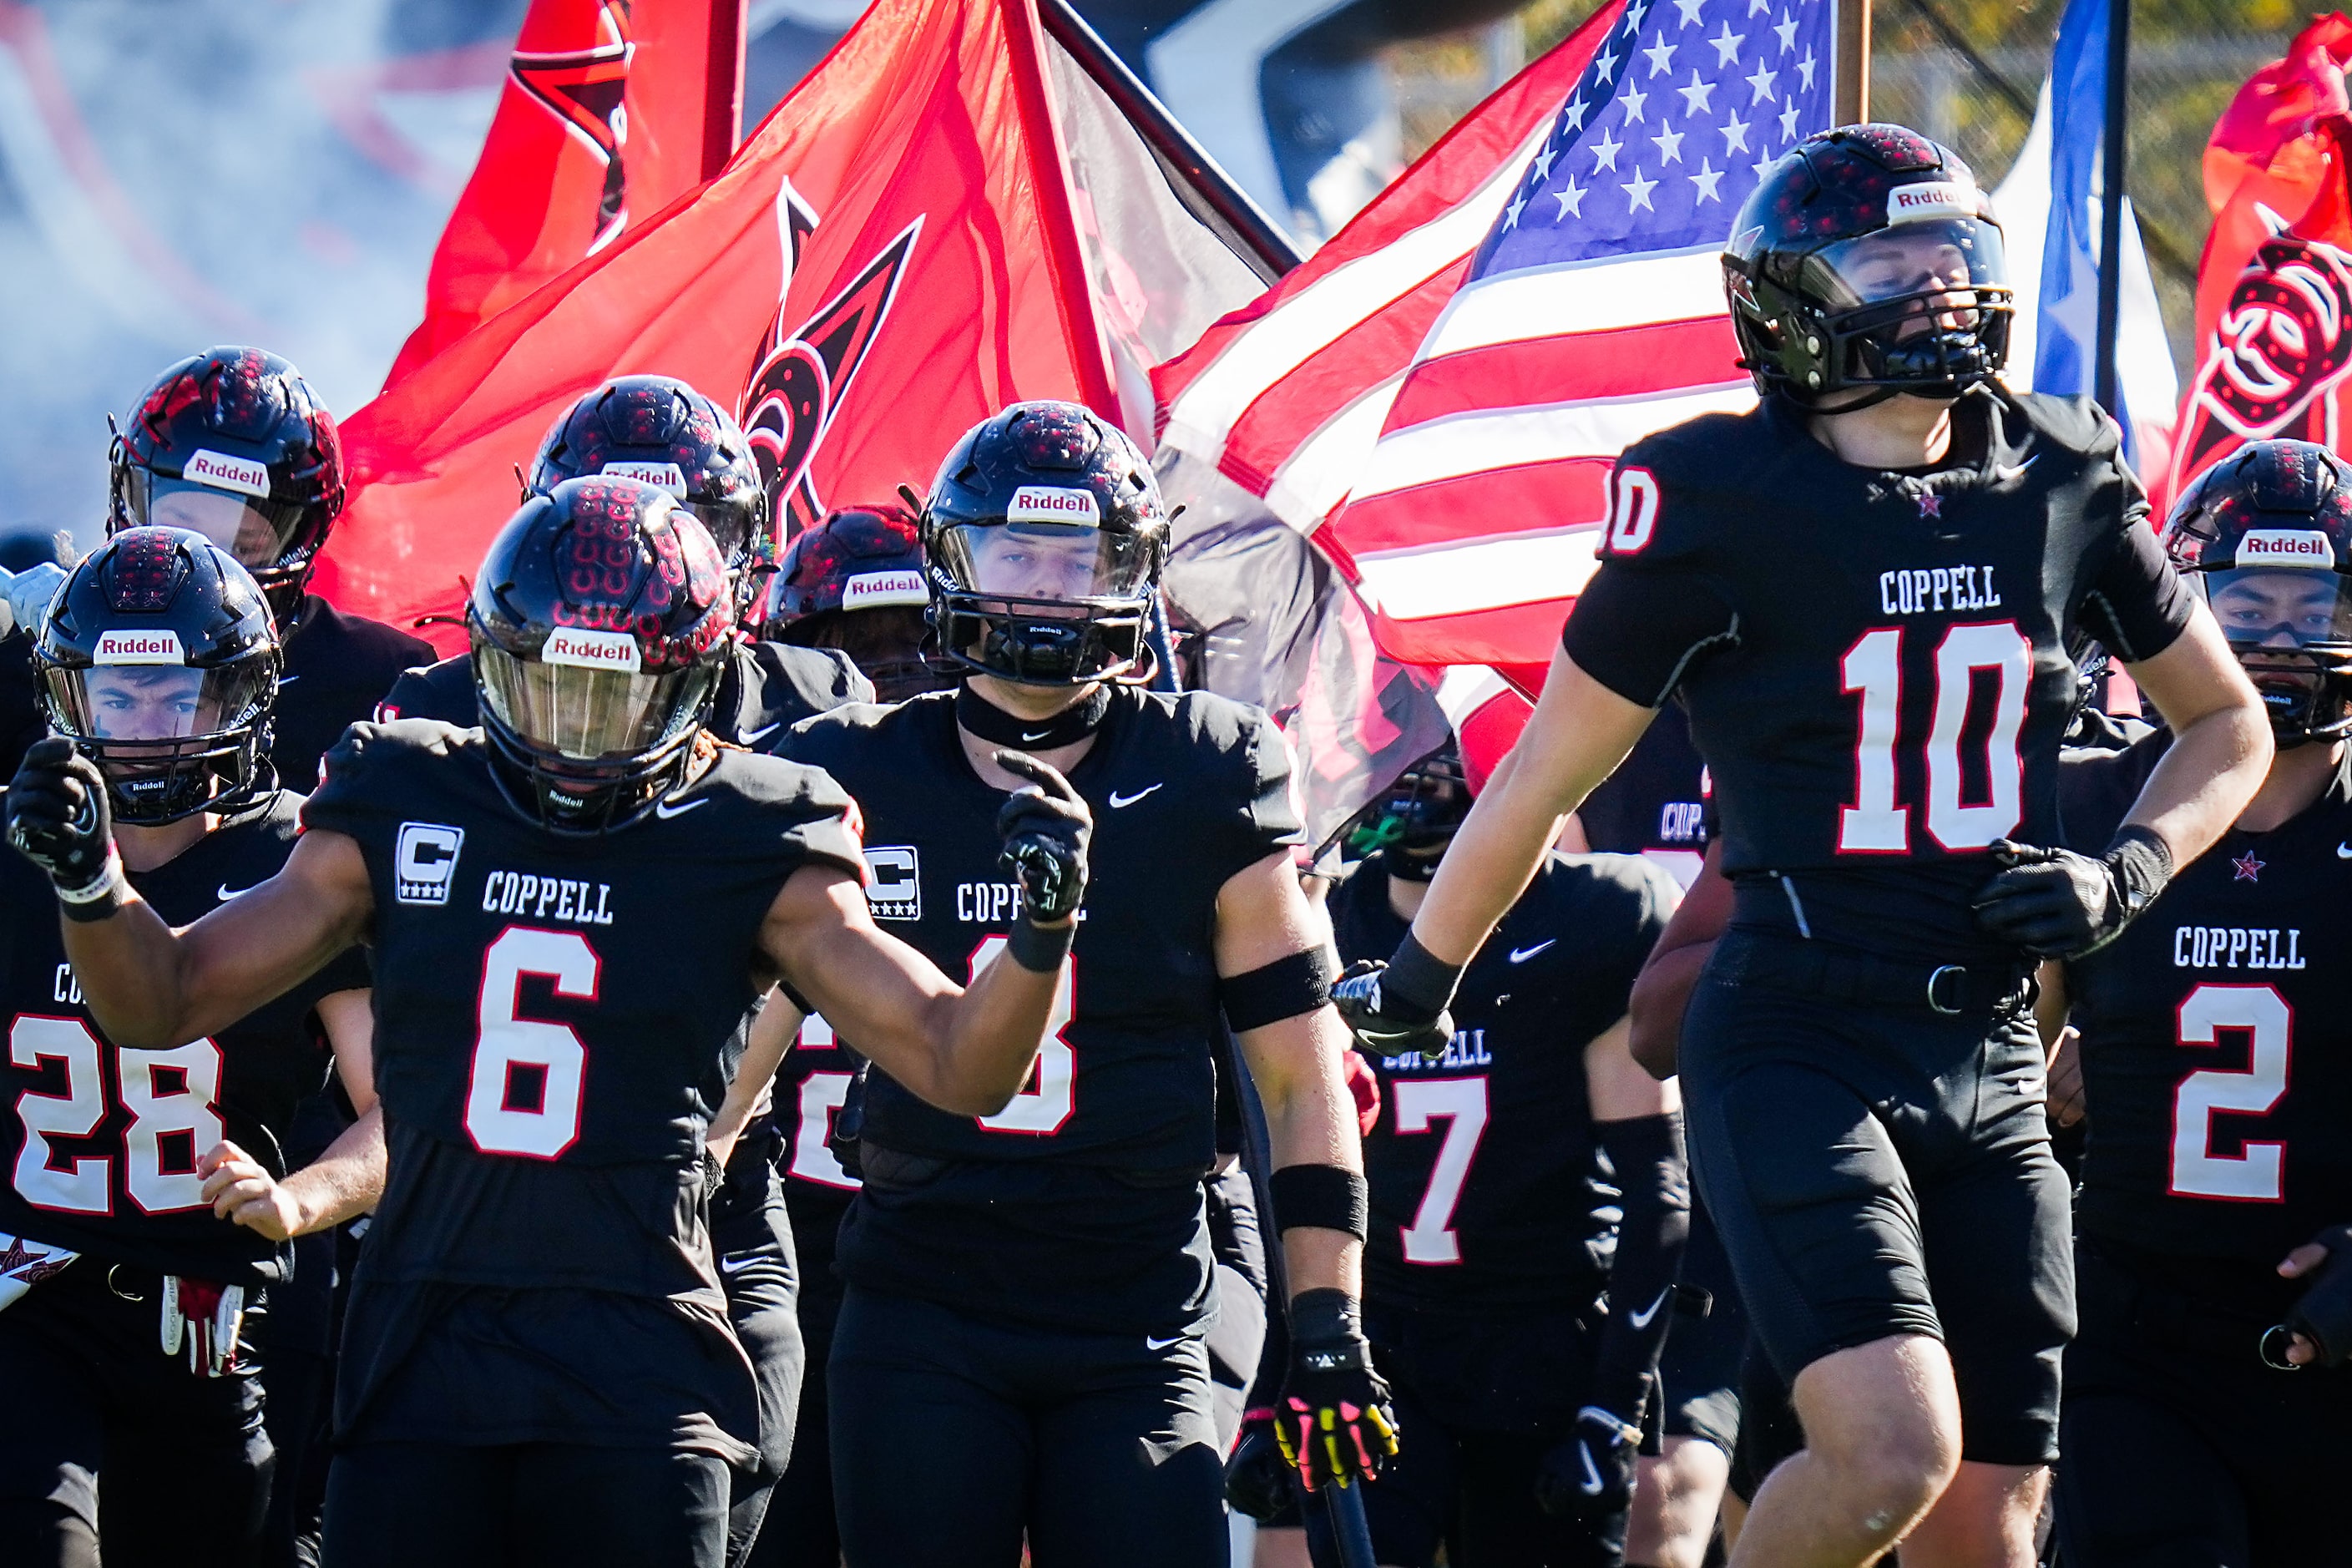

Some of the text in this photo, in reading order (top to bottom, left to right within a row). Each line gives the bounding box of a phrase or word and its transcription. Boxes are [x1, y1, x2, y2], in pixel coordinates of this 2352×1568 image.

[1896, 190, 1961, 209] Ridde
[195, 458, 264, 487] Riddell
[607, 471, 677, 486] dell
[1019, 494, 1090, 512] Riddell
[2248, 539, 2324, 554] Riddell
[852, 577, 920, 595] Riddell
[1880, 564, 2001, 615] COPPELL
[103, 639, 174, 654] Riddell
[554, 639, 631, 660] Riddell
[1836, 618, 2033, 855] 10
[132, 781, 164, 791] Riddell
[400, 826, 458, 882] C
[863, 850, 916, 901] C
[482, 870, 614, 925] COPPELL
[2173, 926, 2306, 969] COPPELL
[463, 924, 604, 1161] 6
[8, 1011, 227, 1217] 28
[2168, 982, 2294, 1203] 2
[1392, 1074, 1490, 1267] 7
